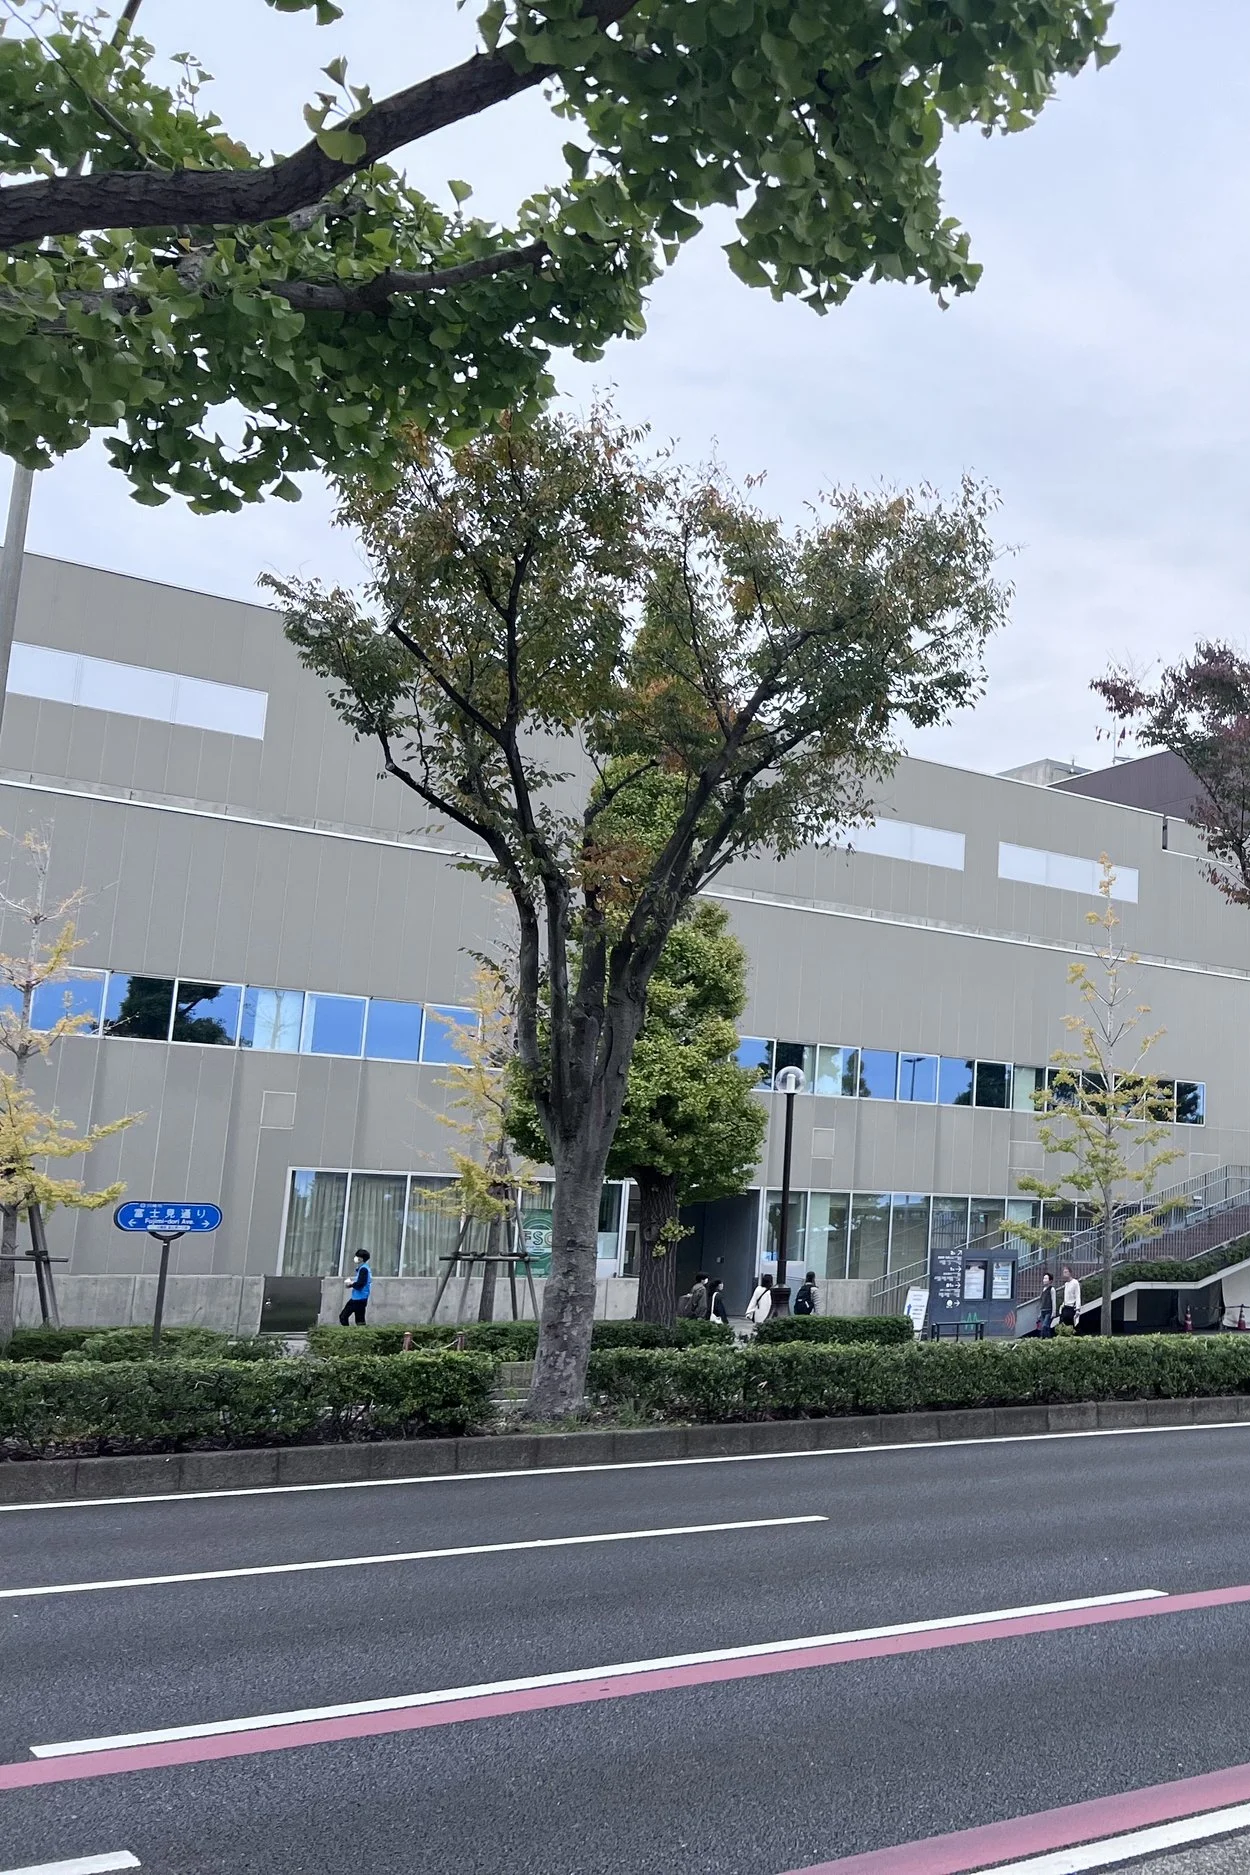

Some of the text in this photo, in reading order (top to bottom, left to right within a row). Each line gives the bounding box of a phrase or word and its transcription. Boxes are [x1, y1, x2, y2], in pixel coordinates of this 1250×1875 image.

[134, 1208, 206, 1219] 富士見通り
[144, 1217, 180, 1226] Fujimi-dori
